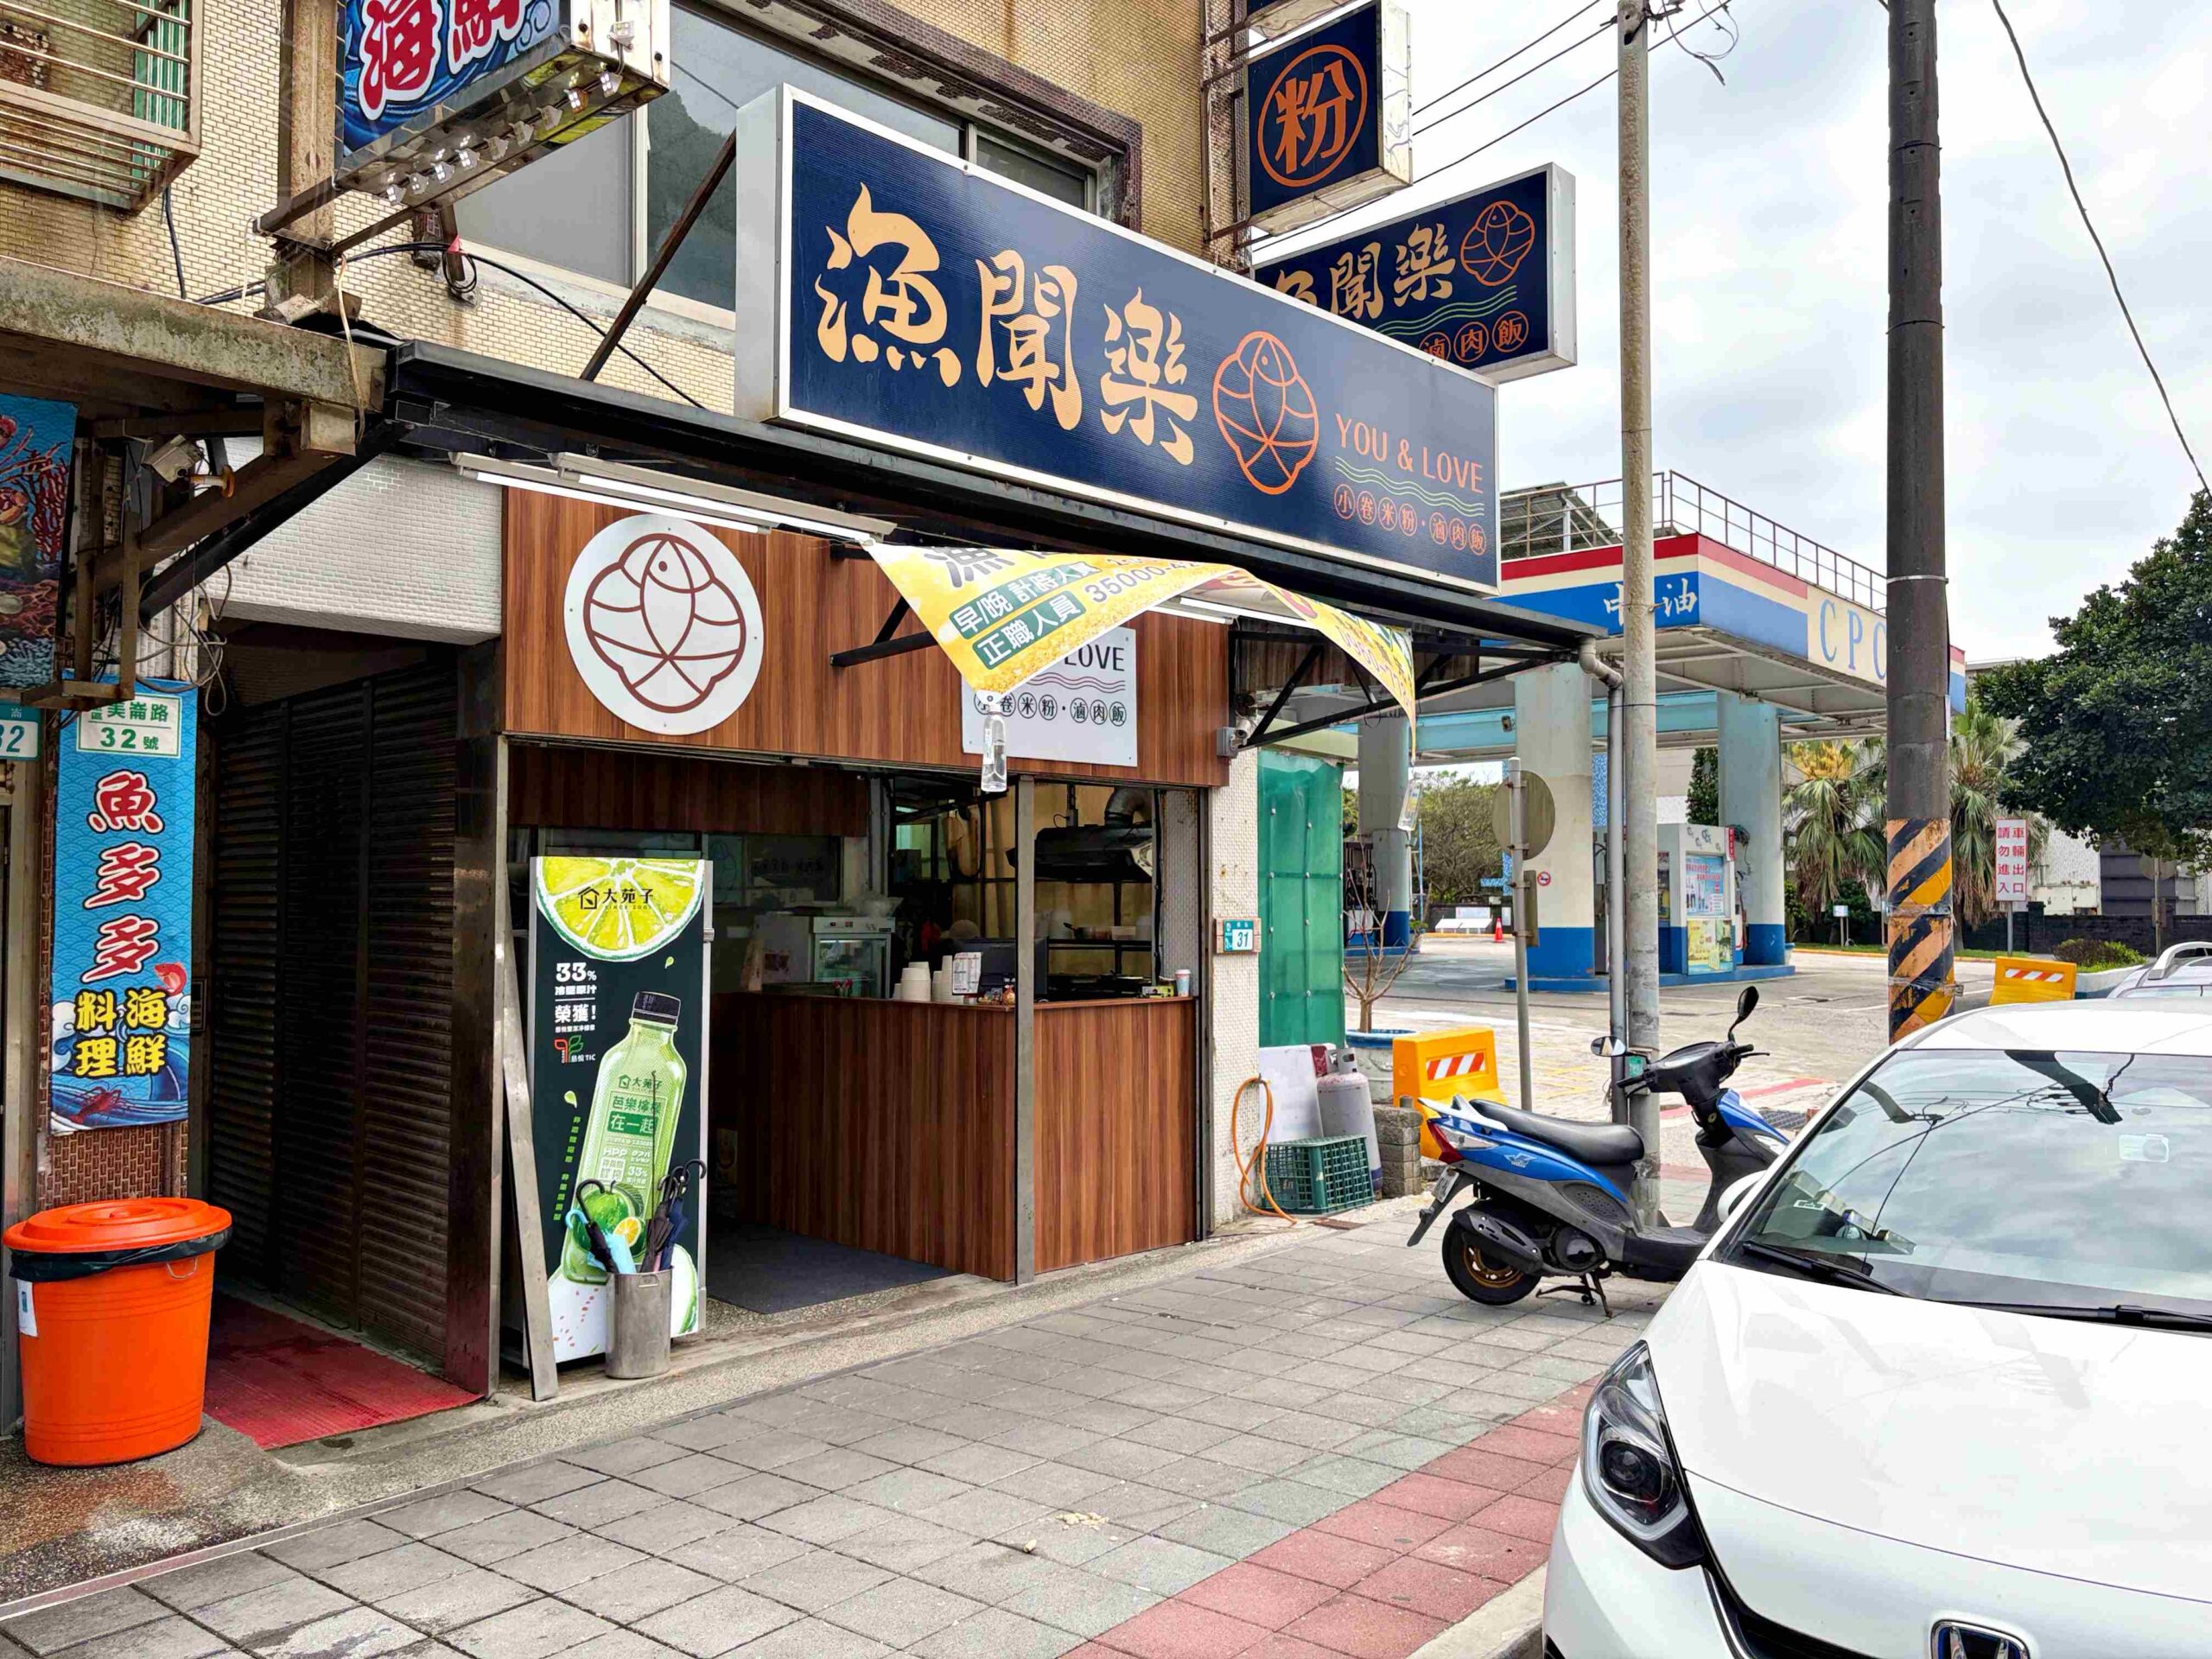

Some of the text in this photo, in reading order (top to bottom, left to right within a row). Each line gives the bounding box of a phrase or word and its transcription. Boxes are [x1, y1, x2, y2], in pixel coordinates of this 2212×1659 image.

[1274, 59, 1356, 175] 粉
[814, 181, 1198, 466] 漁聞樂
[1335, 413, 1484, 494] YOU & LOVE
[953, 562, 1103, 632] 早/晚 計時人員
[977, 594, 1081, 666] 正職人員
[0, 724, 25, 753] 2
[81, 769, 163, 982] 魚多多
[1998, 827, 2010, 893] 請勿進入
[2012, 827, 2024, 893] 車輛出口
[602, 888, 653, 904] 大苑子
[556, 962, 597, 982] 33%
[1237, 931, 1249, 947] 31
[75, 991, 117, 1077] 料理
[125, 989, 168, 1074] 海鮮
